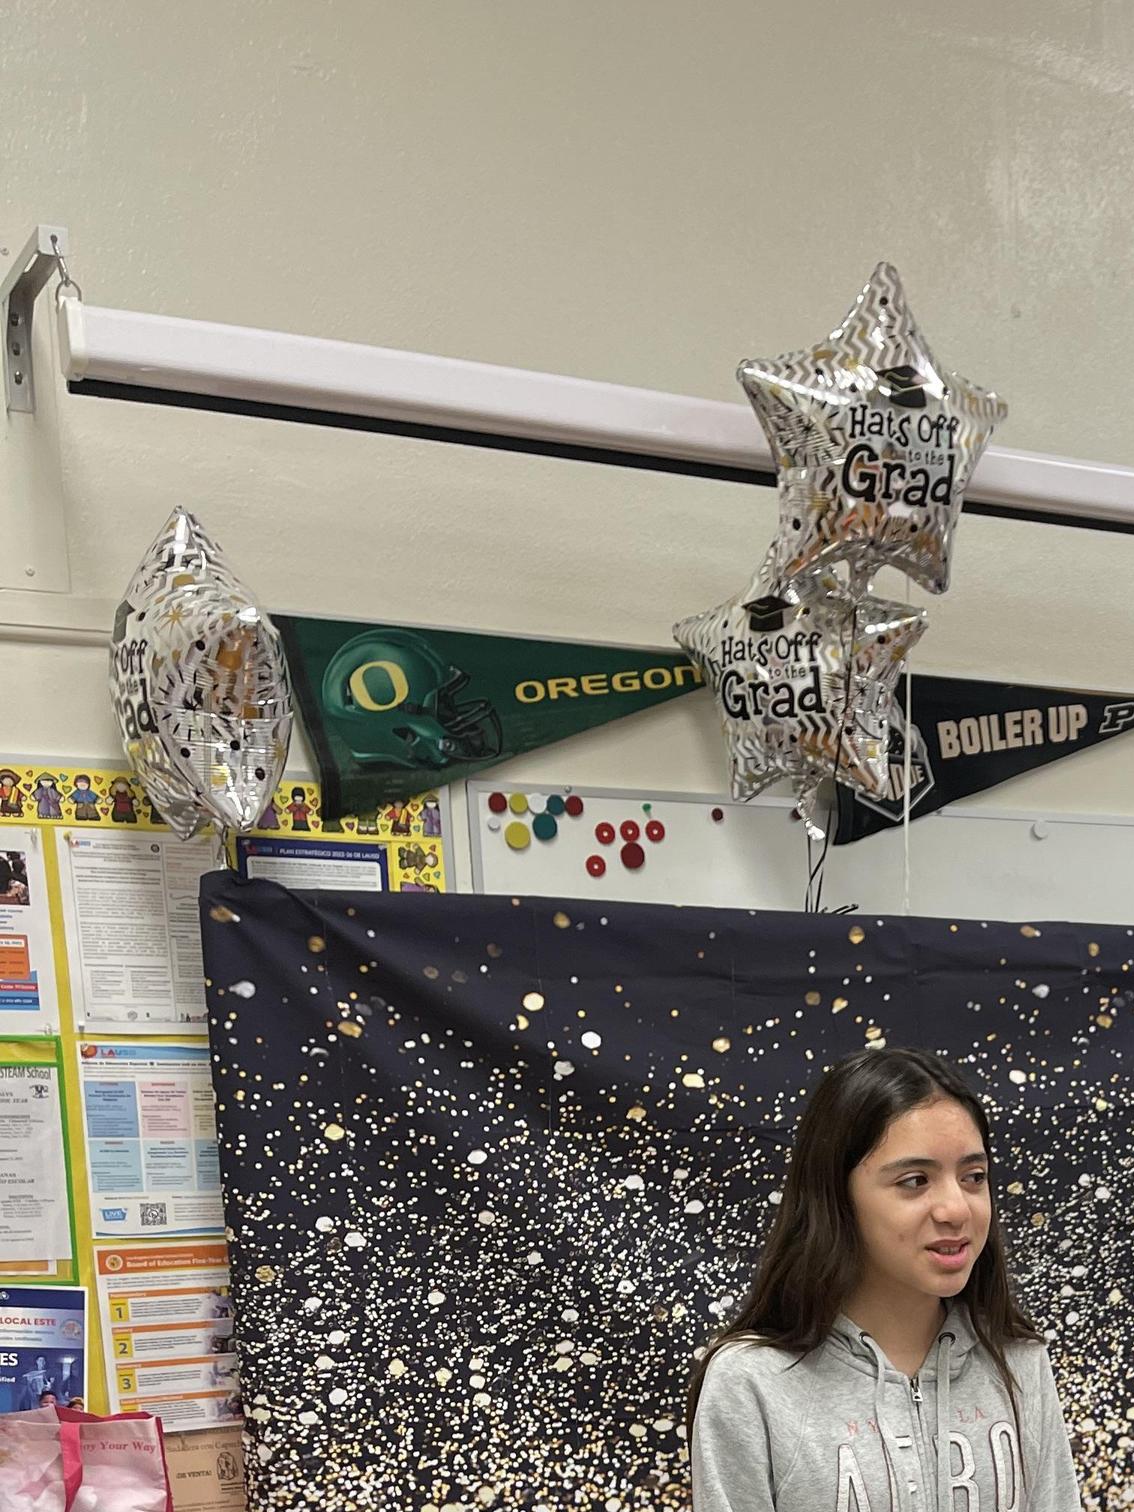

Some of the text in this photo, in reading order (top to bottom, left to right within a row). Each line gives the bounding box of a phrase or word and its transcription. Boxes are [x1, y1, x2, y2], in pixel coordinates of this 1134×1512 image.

[847, 404, 960, 450] Hats Off
[908, 449, 944, 467] to the
[842, 443, 956, 507] Grad
[720, 632, 823, 668] Hats Off
[768, 663, 806, 679] to the
[349, 660, 409, 712] O
[514, 665, 702, 703] OREGON
[720, 667, 826, 721] Grad
[937, 708, 1045, 760] BOILER
[1047, 704, 1088, 742] UP
[27, 1066, 51, 1080] School
[0, 1317, 56, 1326] LOCAL ESTE
[116, 1307, 122, 1318] 1
[119, 1343, 128, 1354] 2
[122, 1378, 132, 1390] 3
[100, 1441, 128, 1451] Your
[132, 1441, 156, 1453] Way
